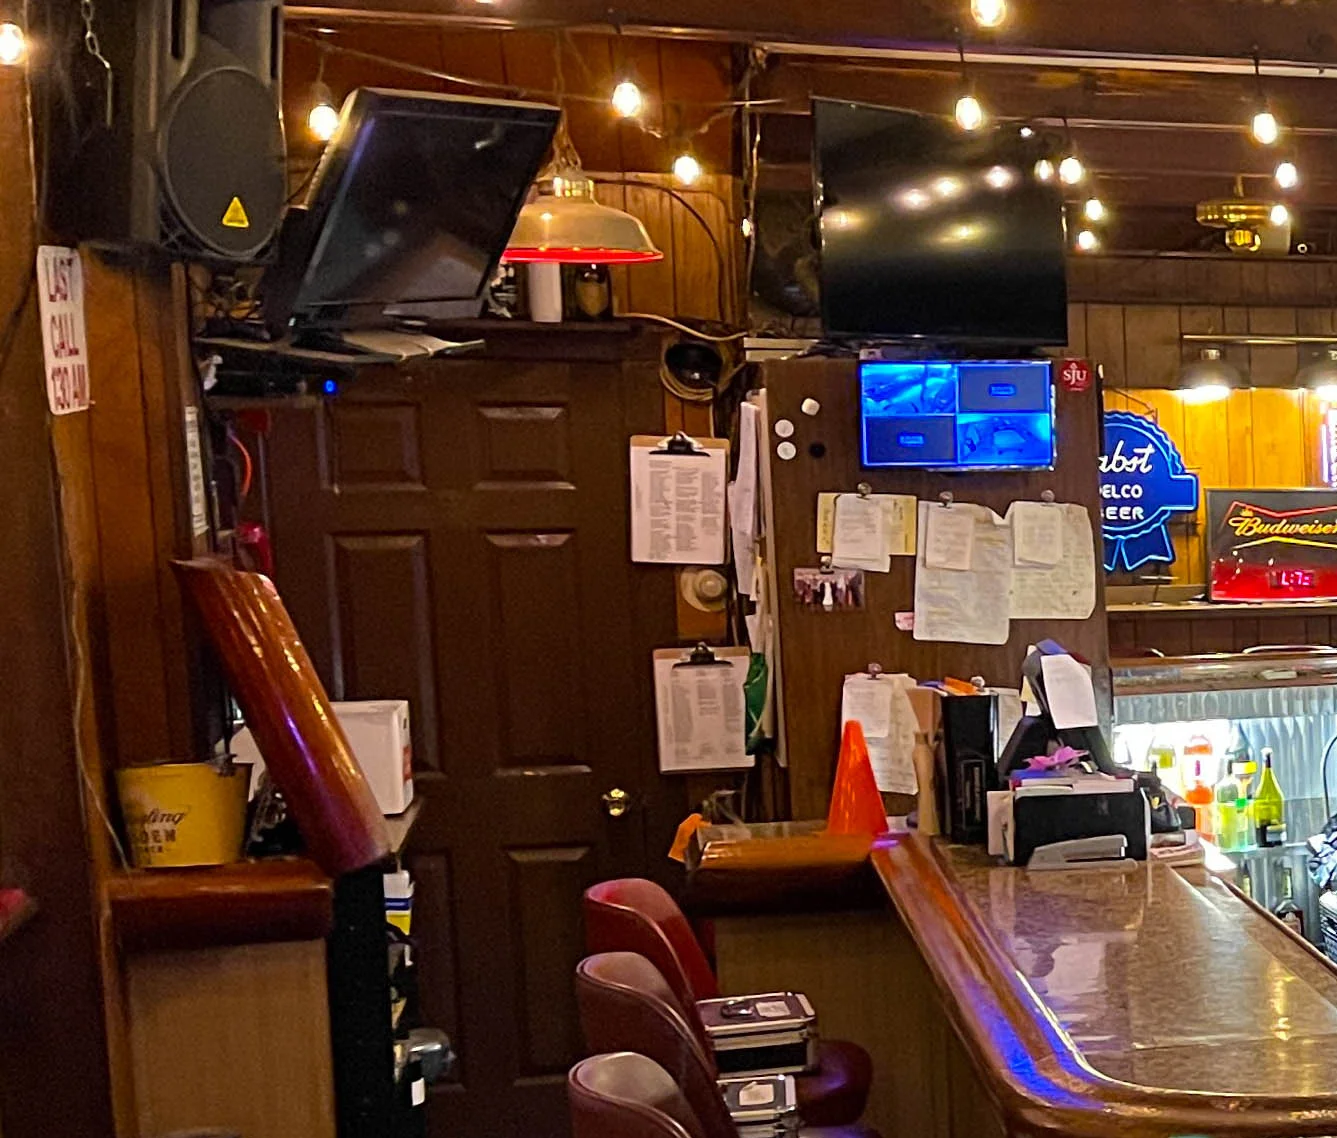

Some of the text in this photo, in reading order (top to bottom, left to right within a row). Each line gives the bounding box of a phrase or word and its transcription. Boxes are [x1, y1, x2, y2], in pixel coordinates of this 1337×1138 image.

[45, 257, 72, 302] LAST
[51, 312, 79, 358] CALL
[1098, 440, 1155, 473] abst
[1099, 484, 1143, 499] ELCO
[1100, 506, 1145, 520] EER
